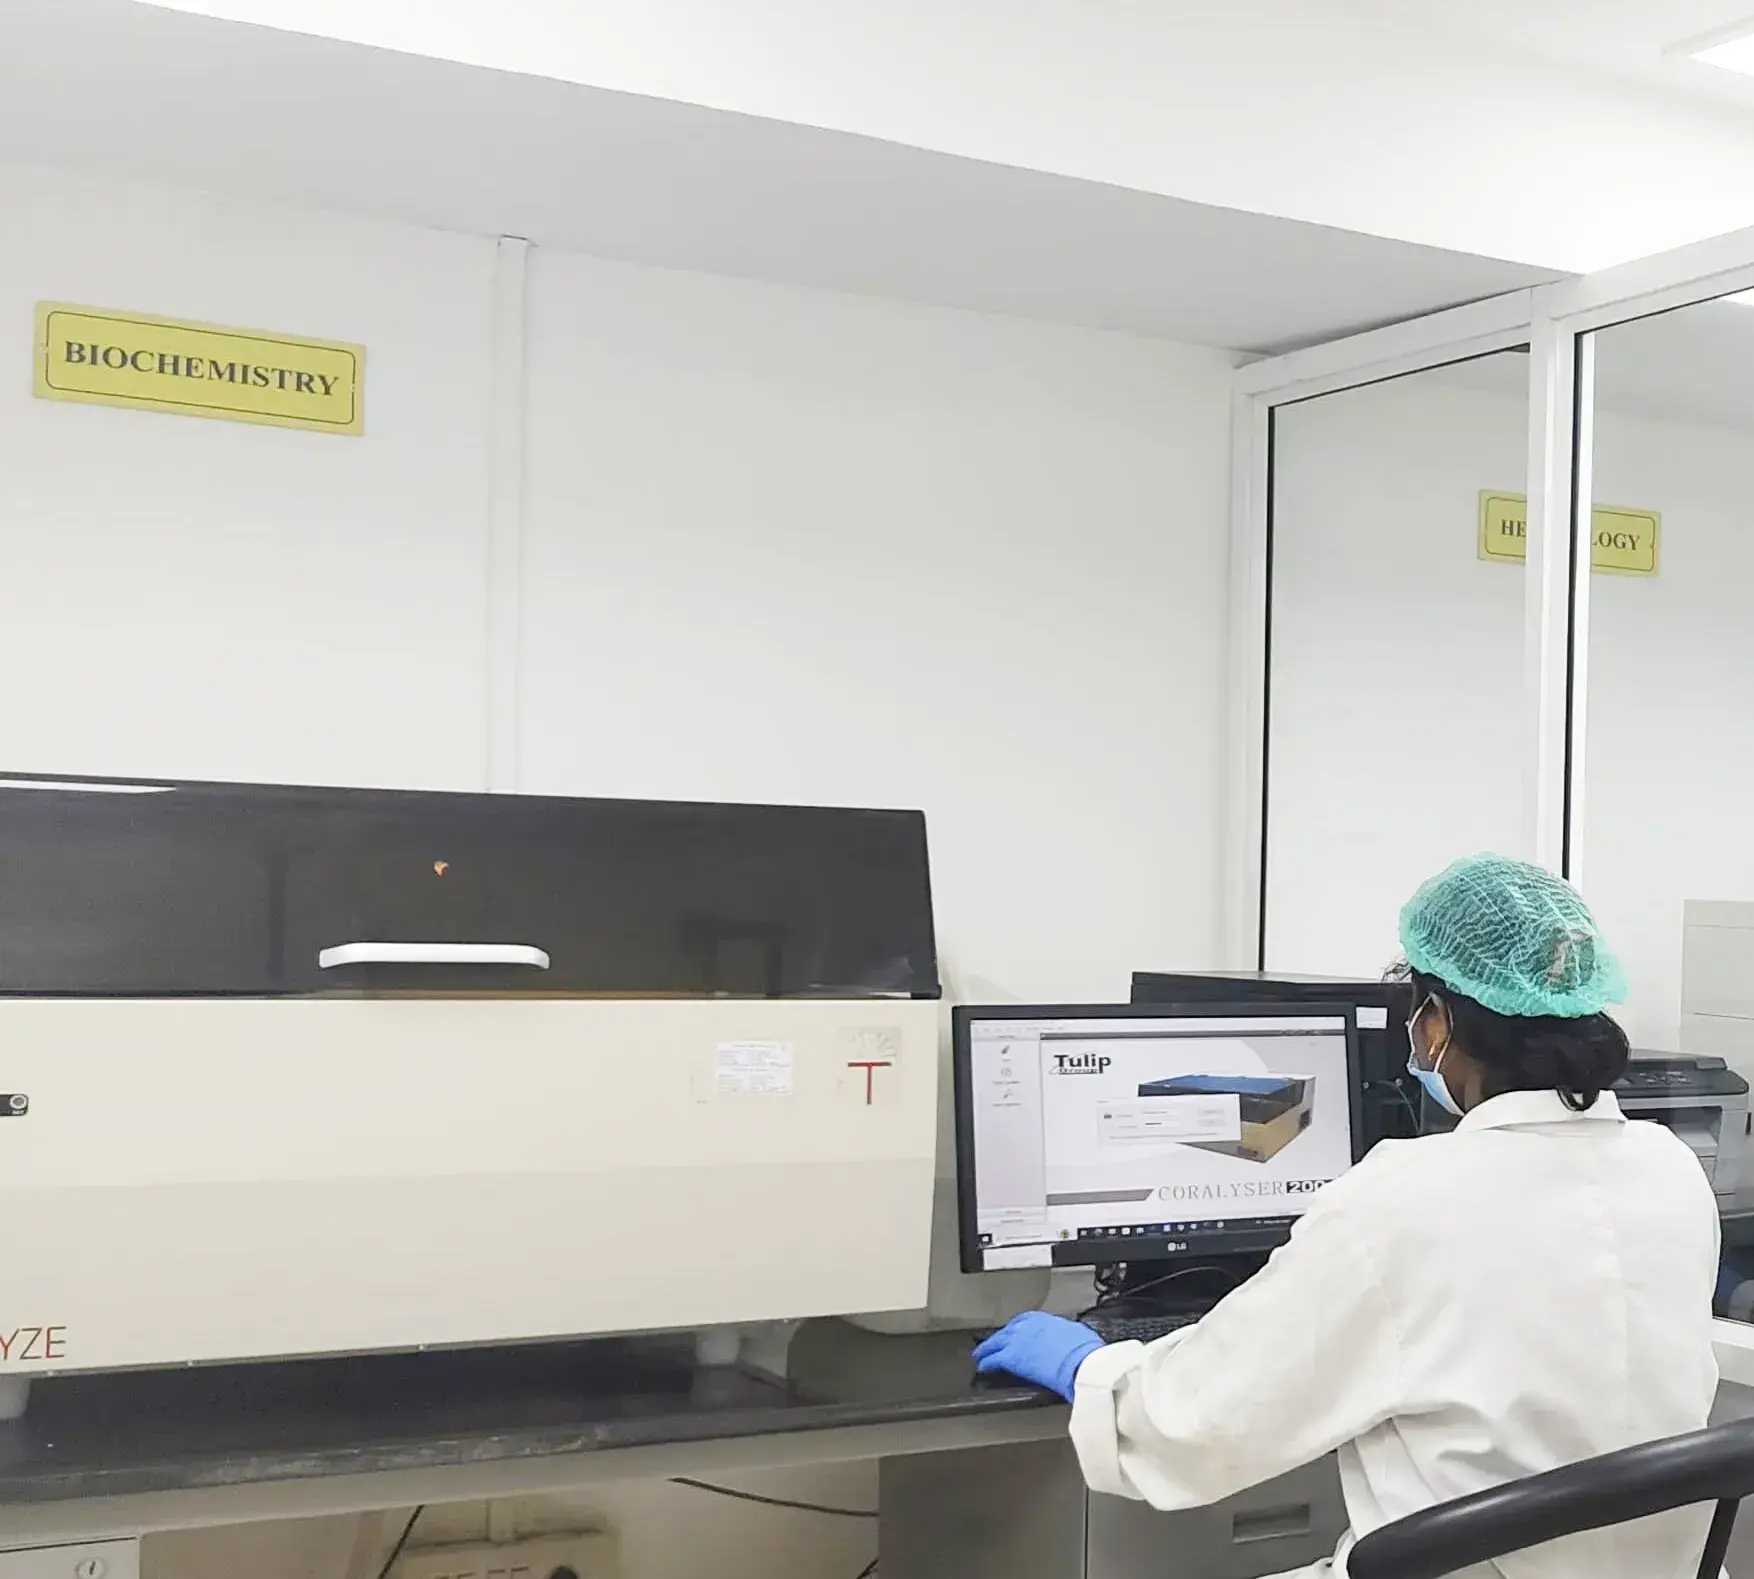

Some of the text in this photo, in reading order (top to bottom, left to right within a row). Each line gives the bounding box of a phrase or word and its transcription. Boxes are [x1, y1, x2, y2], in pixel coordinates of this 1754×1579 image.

[64, 340, 339, 397] BIOCHEMISTRY
[1054, 1053, 1111, 1074] Tulip
[1158, 1180, 1284, 1201] CORALYSER
